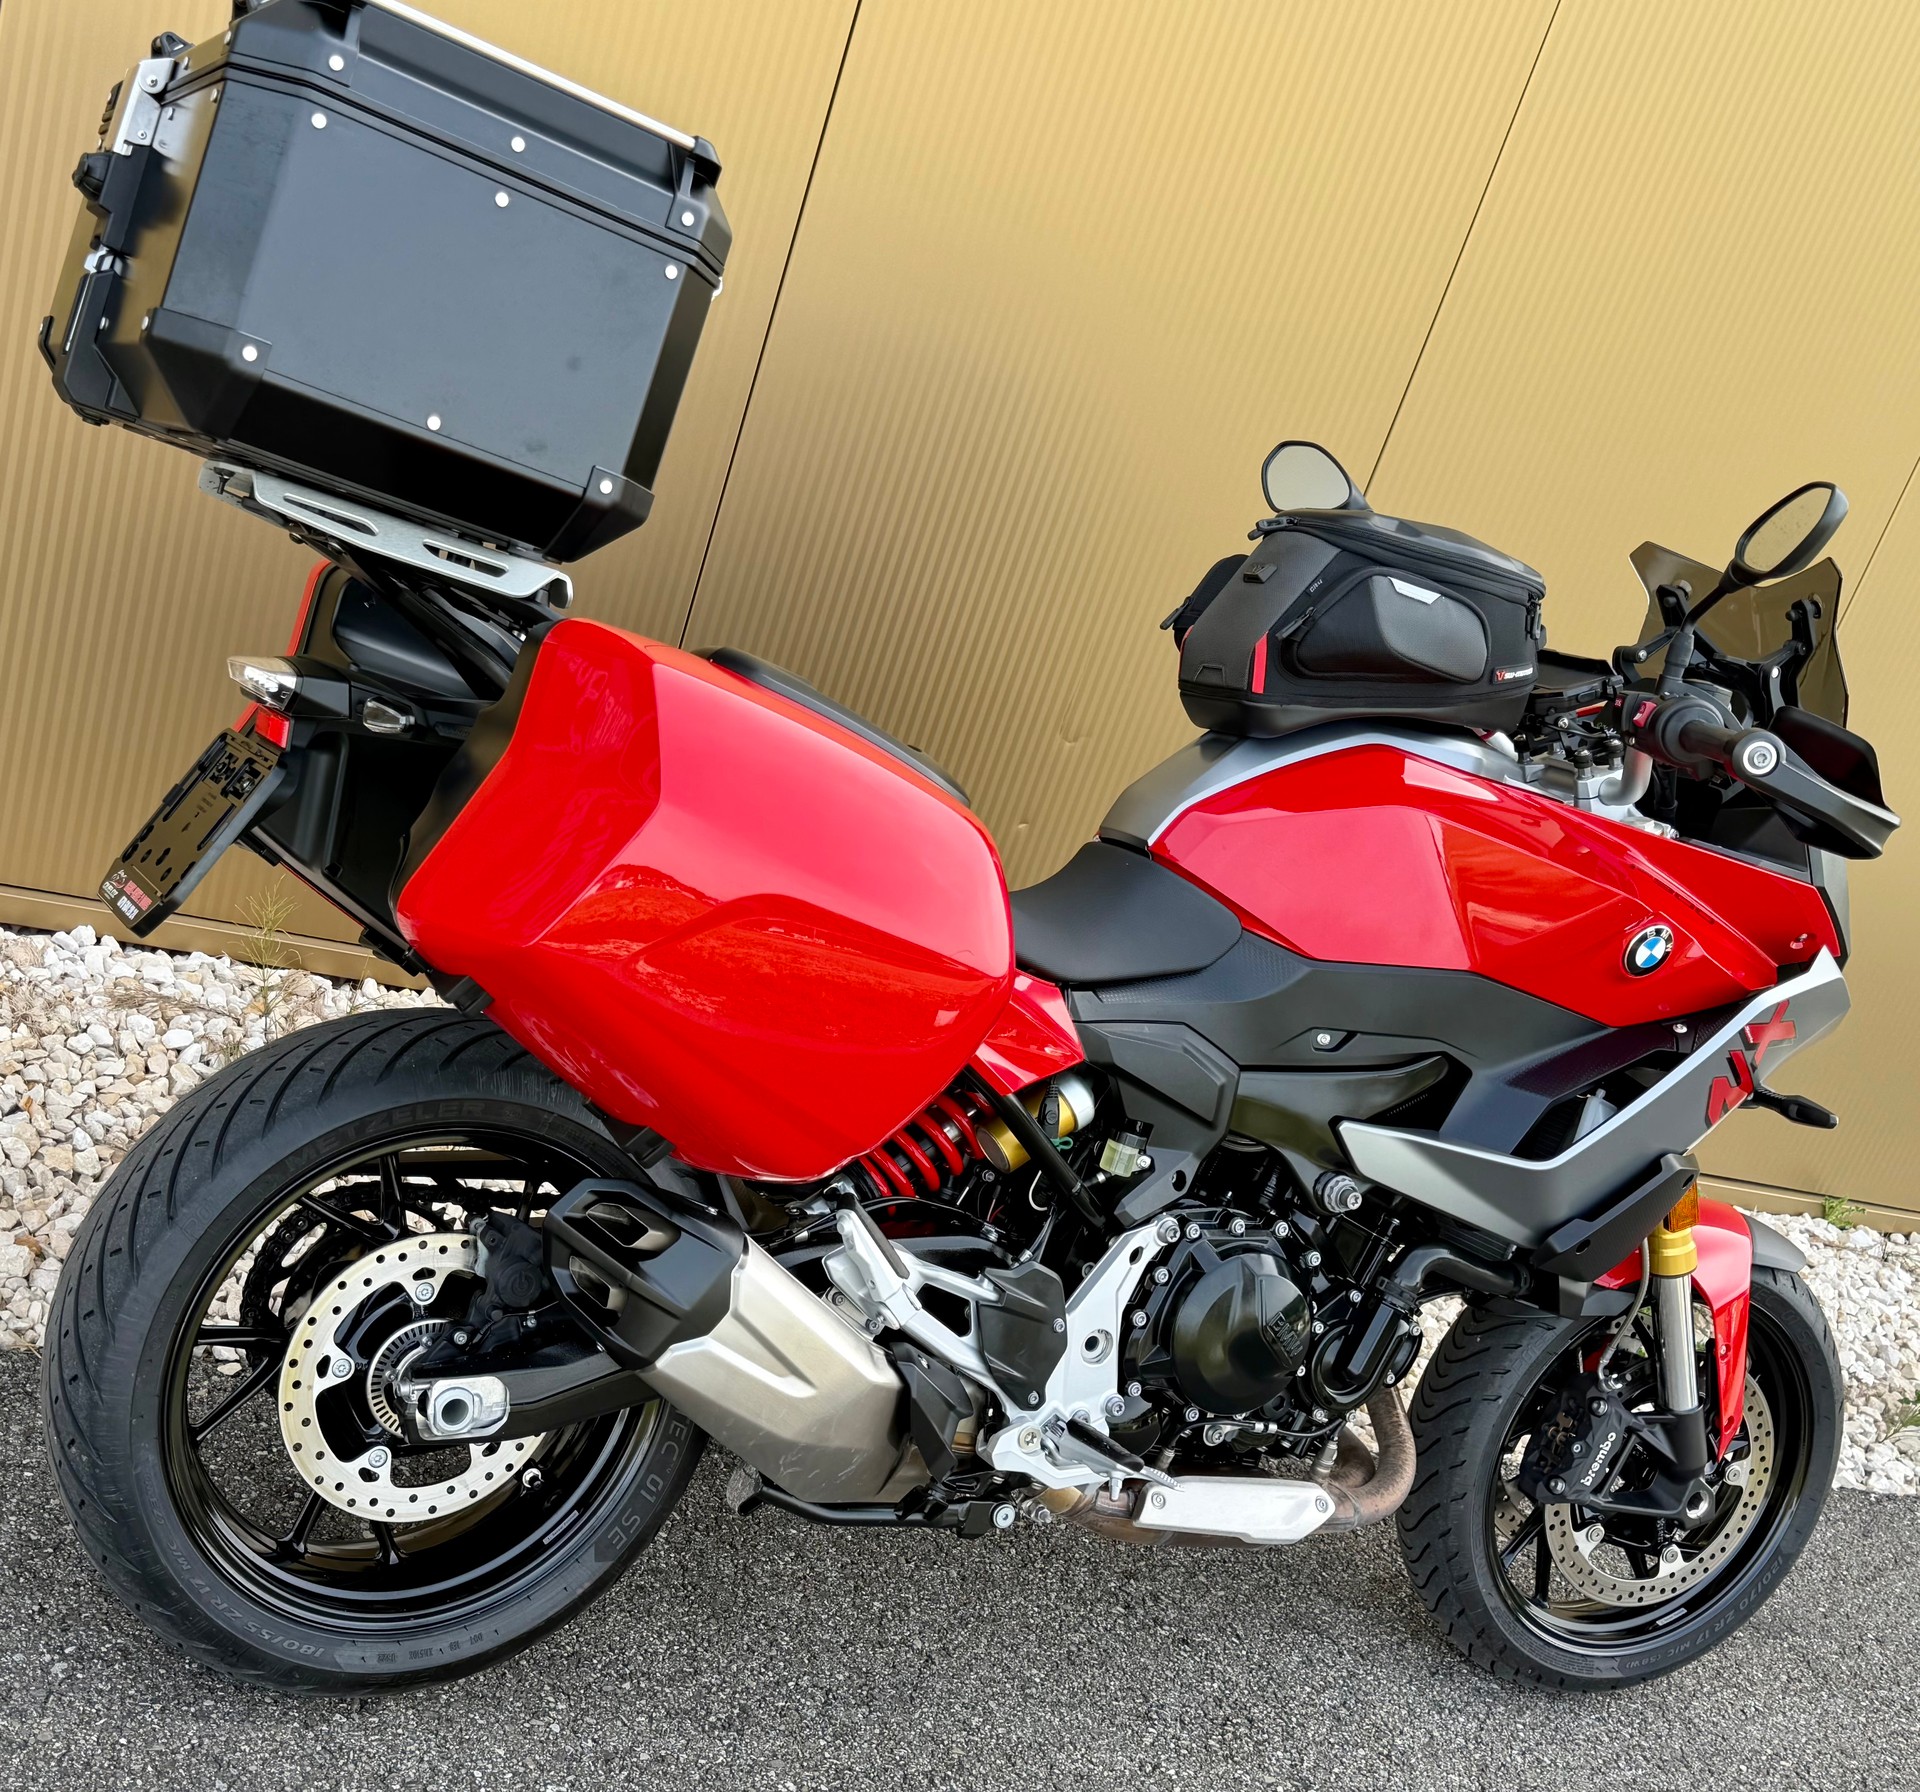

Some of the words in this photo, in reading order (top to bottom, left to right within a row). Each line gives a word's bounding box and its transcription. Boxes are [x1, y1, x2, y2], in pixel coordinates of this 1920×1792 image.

[1646, 929, 1673, 952] BMW
[1269, 1311, 1303, 1357] BMW
[1580, 1431, 1617, 1487] brembo
[243, 1622, 325, 1658] 180/55
